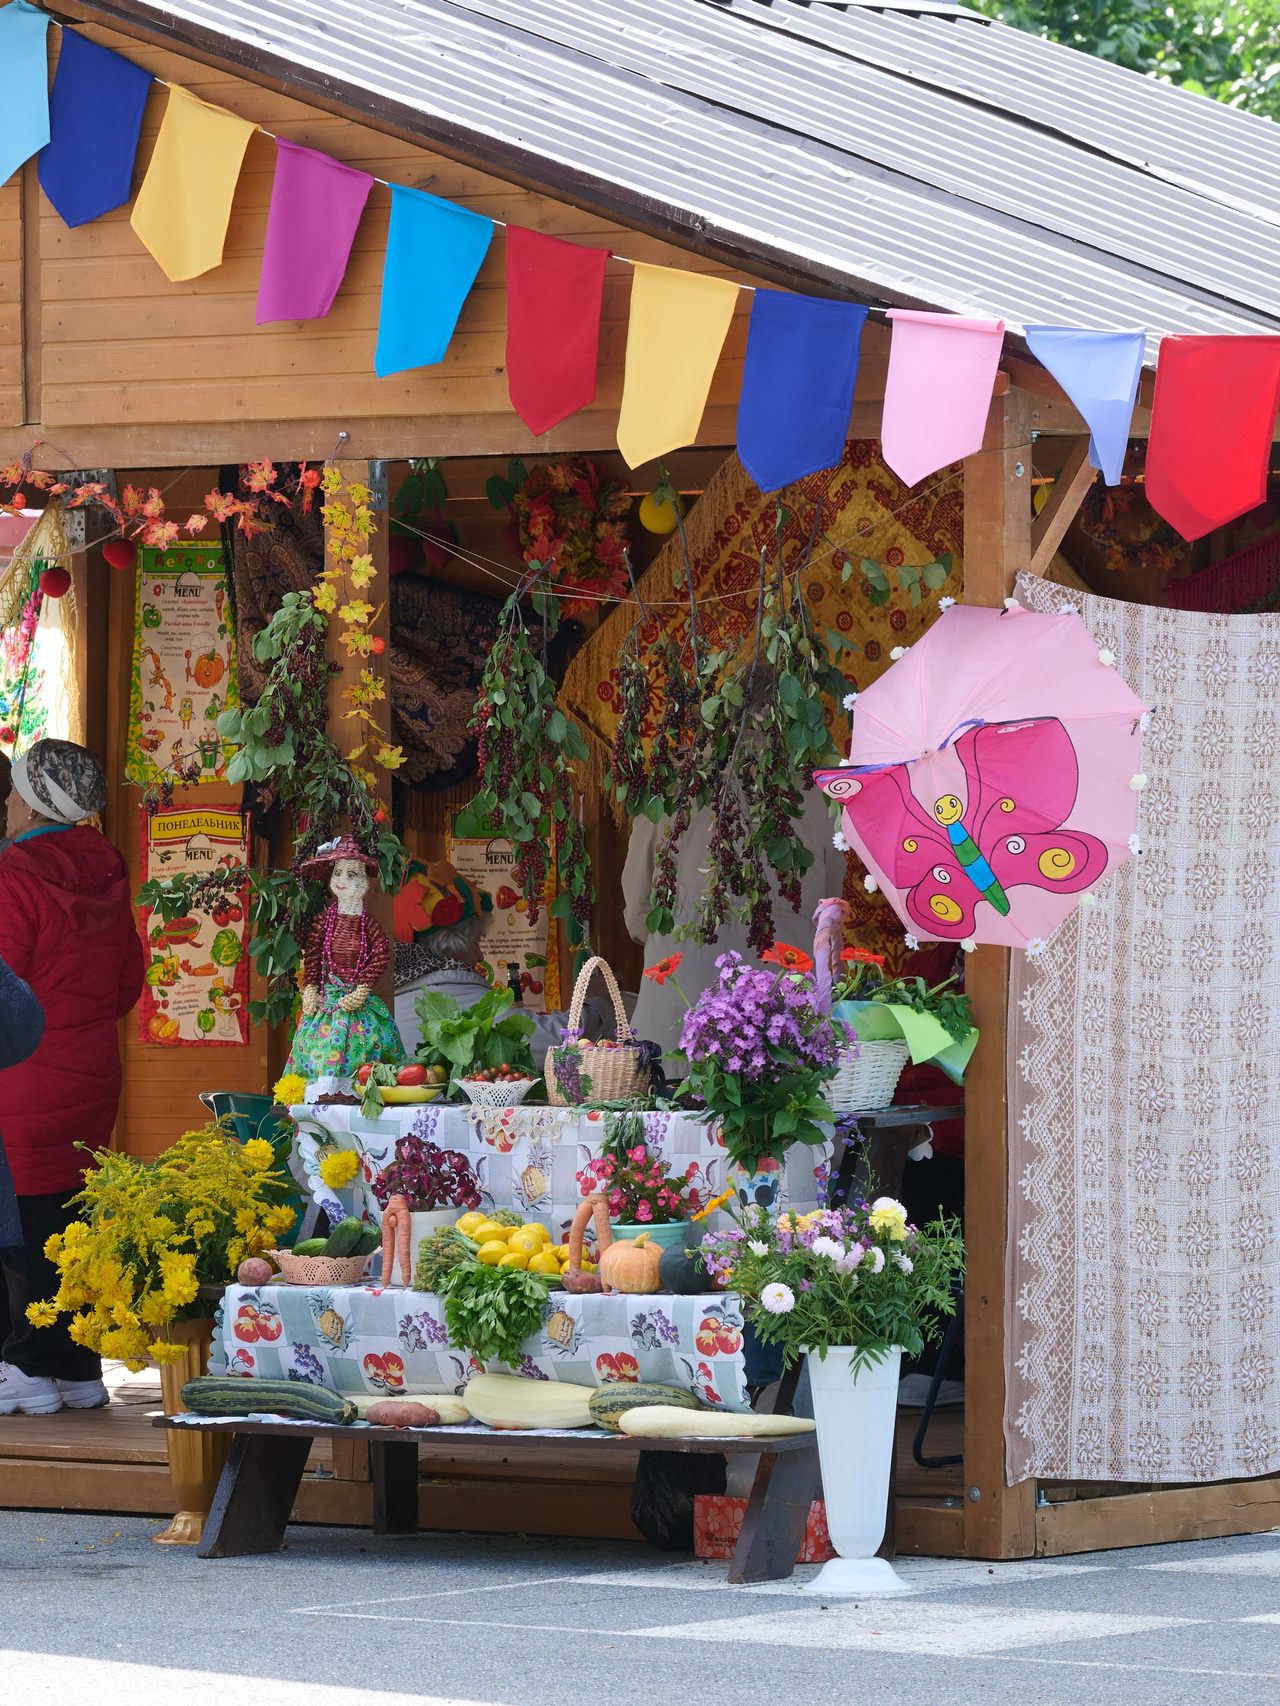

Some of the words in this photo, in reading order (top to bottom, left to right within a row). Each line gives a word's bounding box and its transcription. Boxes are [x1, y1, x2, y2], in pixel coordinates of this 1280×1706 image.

[173, 586, 201, 598] MENU
[157, 818, 240, 832] ПОНЕДЕЛЬНИК
[185, 850, 213, 861] MENU
[485, 854, 514, 865] MENU
